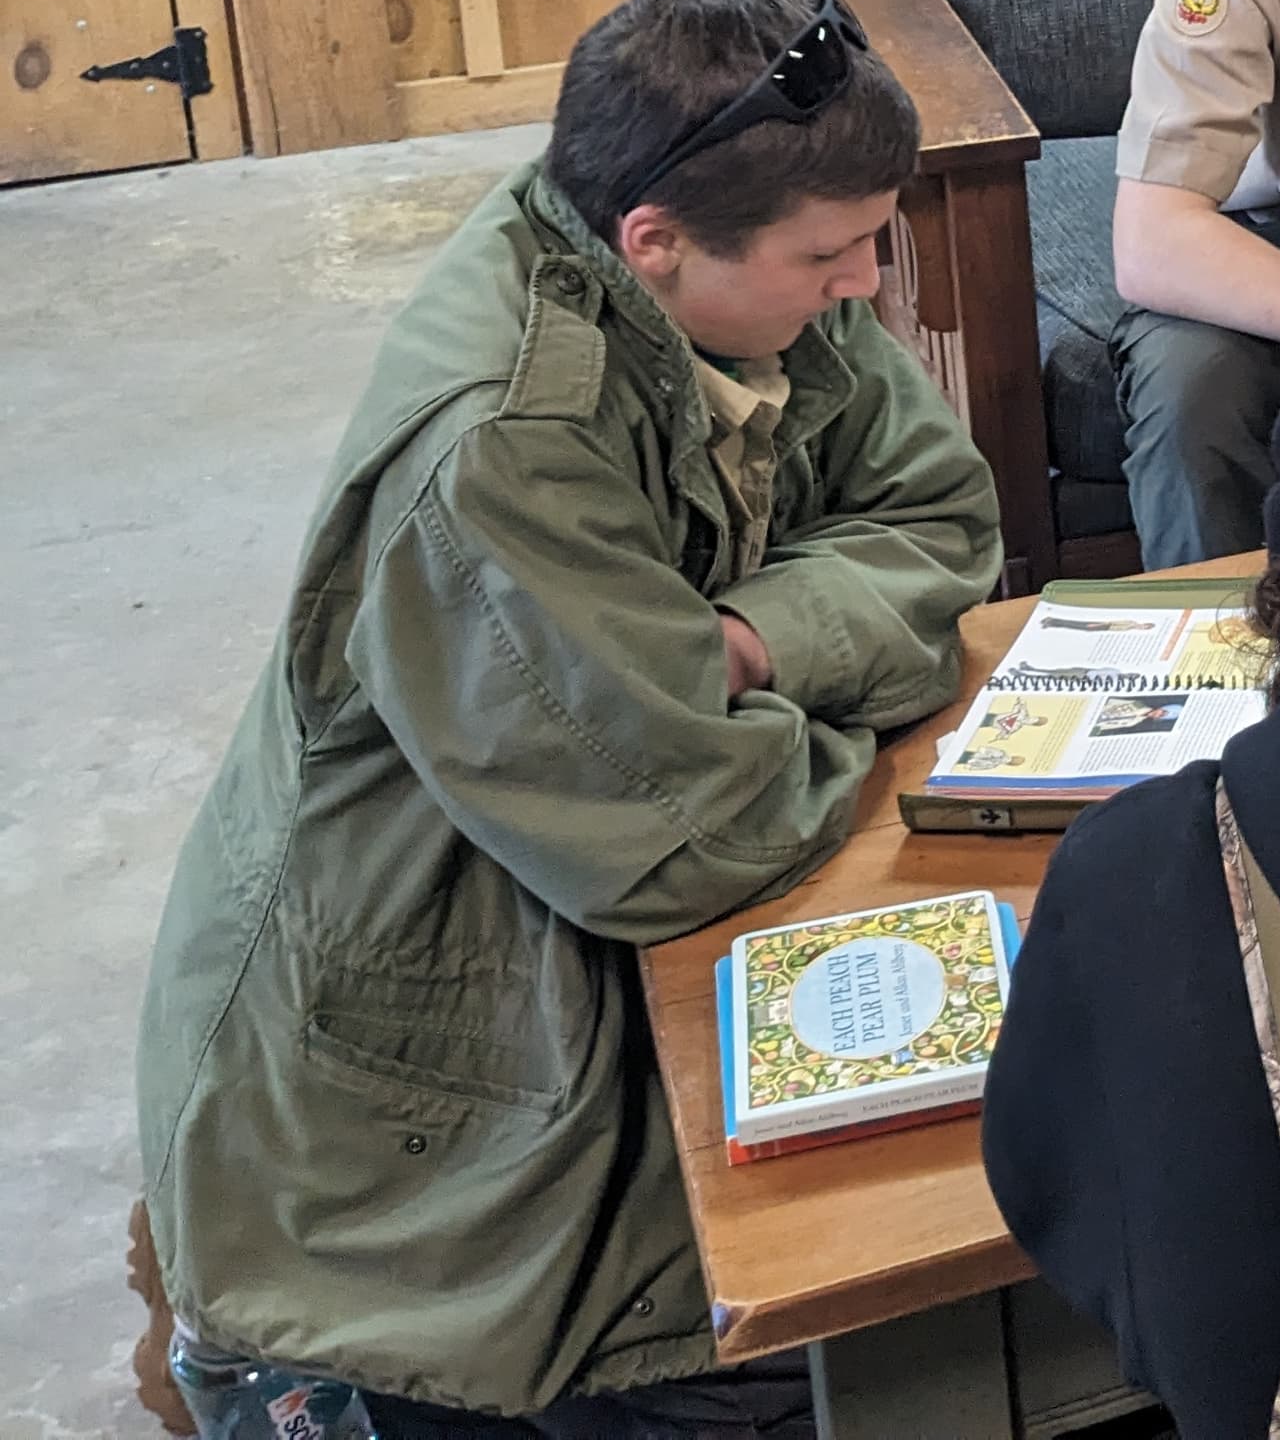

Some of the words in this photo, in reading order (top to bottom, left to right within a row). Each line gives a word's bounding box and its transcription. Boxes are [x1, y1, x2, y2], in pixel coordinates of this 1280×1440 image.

[827, 952, 853, 1006] PEACH
[855, 951, 881, 998] PLUM
[831, 1007, 857, 1053] EACH
[860, 998, 886, 1043] PEAR
